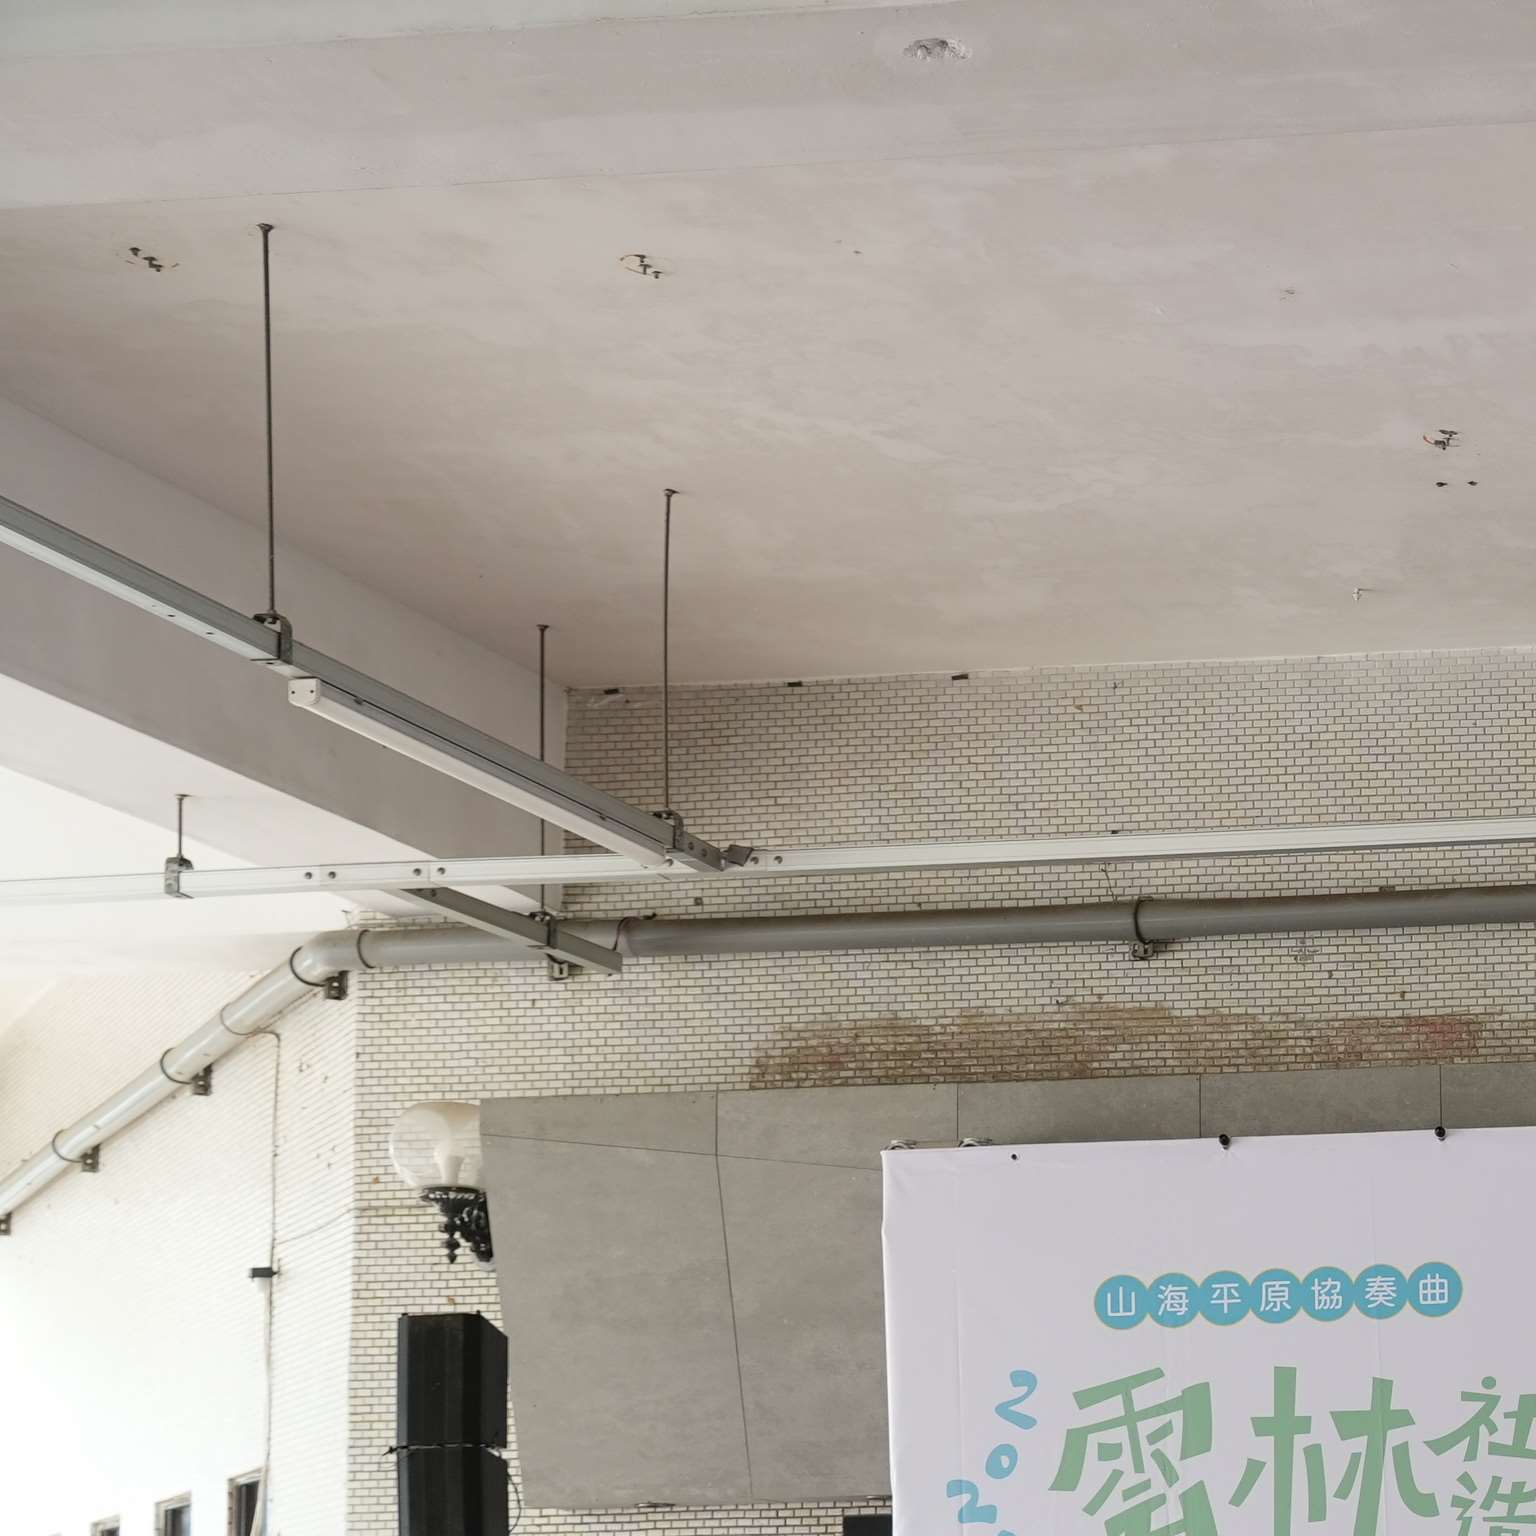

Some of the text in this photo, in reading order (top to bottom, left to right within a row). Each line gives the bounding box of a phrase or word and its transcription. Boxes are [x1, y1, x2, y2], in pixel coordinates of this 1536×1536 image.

[1105, 1272, 1452, 1318] 山海平原協奏曲
